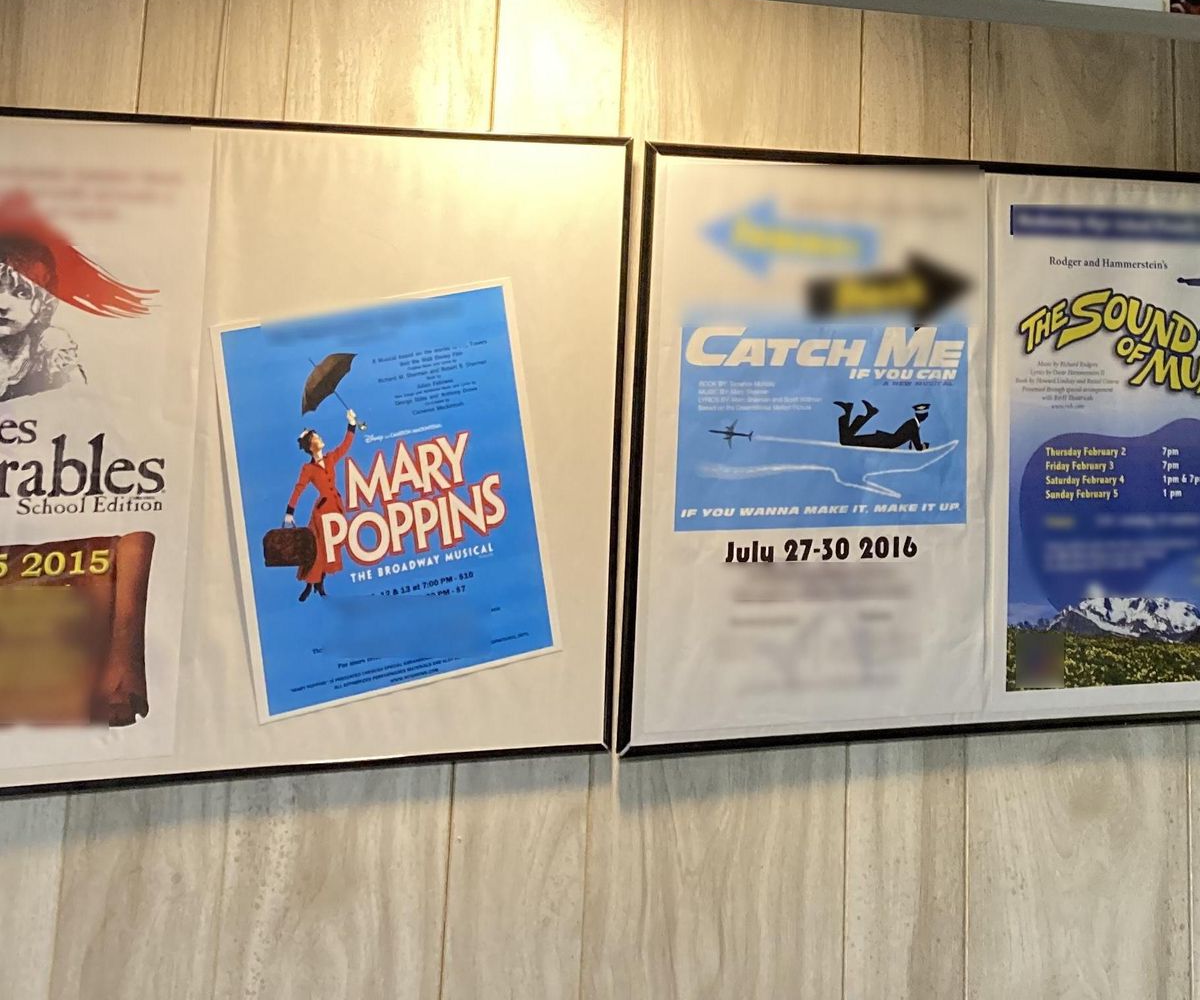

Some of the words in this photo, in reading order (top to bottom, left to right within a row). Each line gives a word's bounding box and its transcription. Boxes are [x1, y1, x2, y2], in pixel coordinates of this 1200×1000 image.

[1049, 256, 1082, 269] Rodger
[1084, 257, 1100, 267] and
[1102, 258, 1168, 270] Hammerstein's
[1019, 299, 1069, 353] THE
[1054, 288, 1200, 354] SOUND
[686, 326, 867, 368] CATCH
[874, 326, 966, 368] ME
[1115, 335, 1151, 364] OF
[848, 368, 871, 380] IF
[874, 368, 914, 380] YOU
[914, 368, 957, 380] CAN
[0, 419, 38, 444] es
[1045, 447, 1082, 458] Thursday
[1083, 447, 1119, 458] February
[1162, 447, 1180, 457] 7pm
[0, 433, 166, 498] rables
[347, 431, 469, 510] MARY
[1045, 461, 1070, 472] Friday
[1072, 461, 1109, 472] February
[1162, 461, 1180, 471] 7pm
[1045, 475, 1081, 486] Saturday
[1082, 475, 1117, 486] February
[1163, 475, 1180, 485] 1pm
[1045, 489, 1075, 500] Sunday
[1076, 489, 1111, 500] February
[1113, 489, 1119, 498] 5
[17, 497, 86, 516] School
[93, 496, 163, 513] Edition
[680, 508, 697, 518] IF
[702, 507, 735, 517] YOU
[739, 506, 800, 517] WANNA
[803, 505, 849, 515] MAKE
[874, 503, 918, 513] MAKE
[922, 502, 937, 512] IT
[320, 473, 506, 564] POPPINS
[725, 541, 775, 563] July
[784, 537, 850, 562] 27-30
[859, 535, 918, 559] 2016
[21, 549, 111, 578] 2015
[350, 569, 373, 584] THE
[378, 556, 440, 578] BROADWAY
[445, 543, 494, 562] MUSICAL
[423, 578, 439, 589] 7:00
